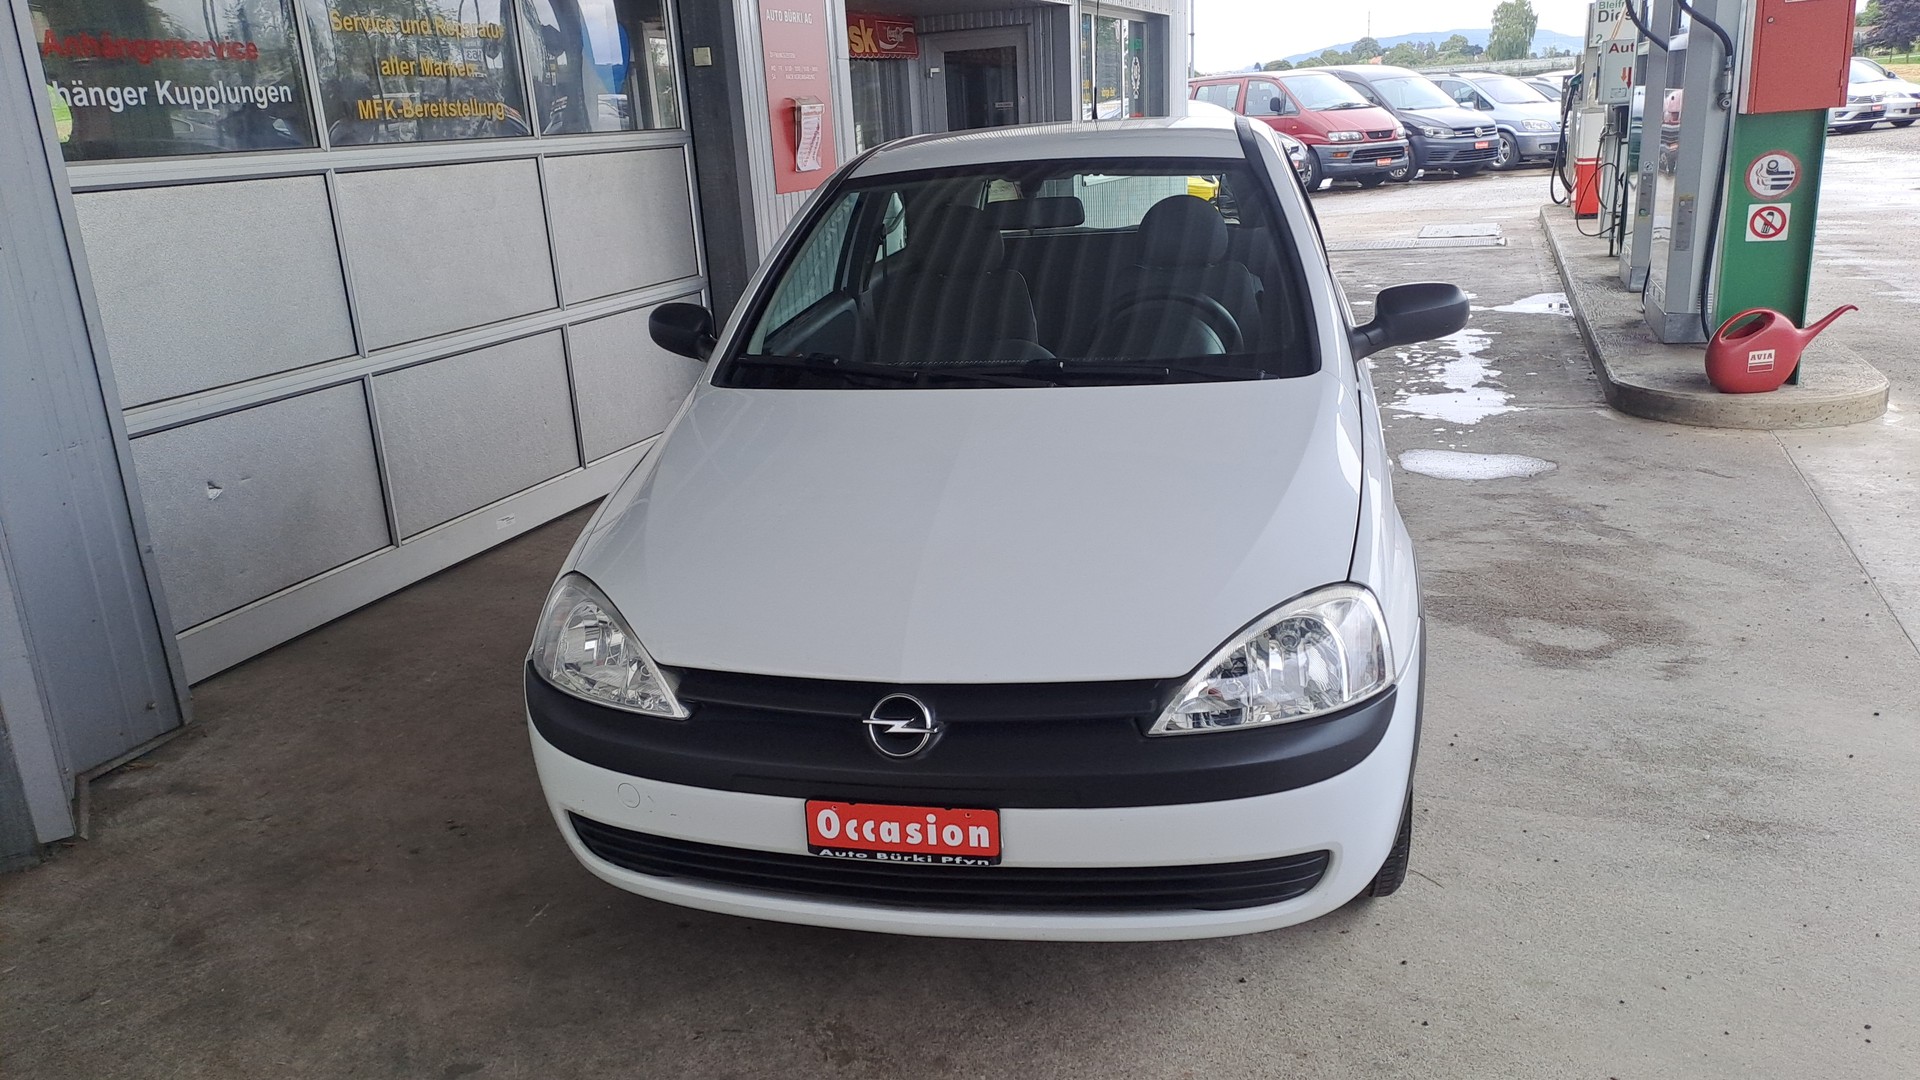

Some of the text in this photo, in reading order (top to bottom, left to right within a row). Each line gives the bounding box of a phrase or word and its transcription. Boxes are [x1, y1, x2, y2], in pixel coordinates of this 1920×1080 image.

[330, 9, 505, 40] Service und Reparatur
[766, 9, 783, 21] AUTO
[784, 9, 803, 23] BÜRKI
[43, 29, 259, 64] Anhängerservice
[848, 19, 878, 53] sk
[381, 56, 475, 77] aller Marken
[155, 80, 292, 111] Kupplungen
[357, 98, 505, 120] MFK-Bereitstellung
[1750, 353, 1773, 361] AVIA
[816, 808, 990, 849] Occasion
[819, 849, 990, 866] Auto Bürki Pfyn
